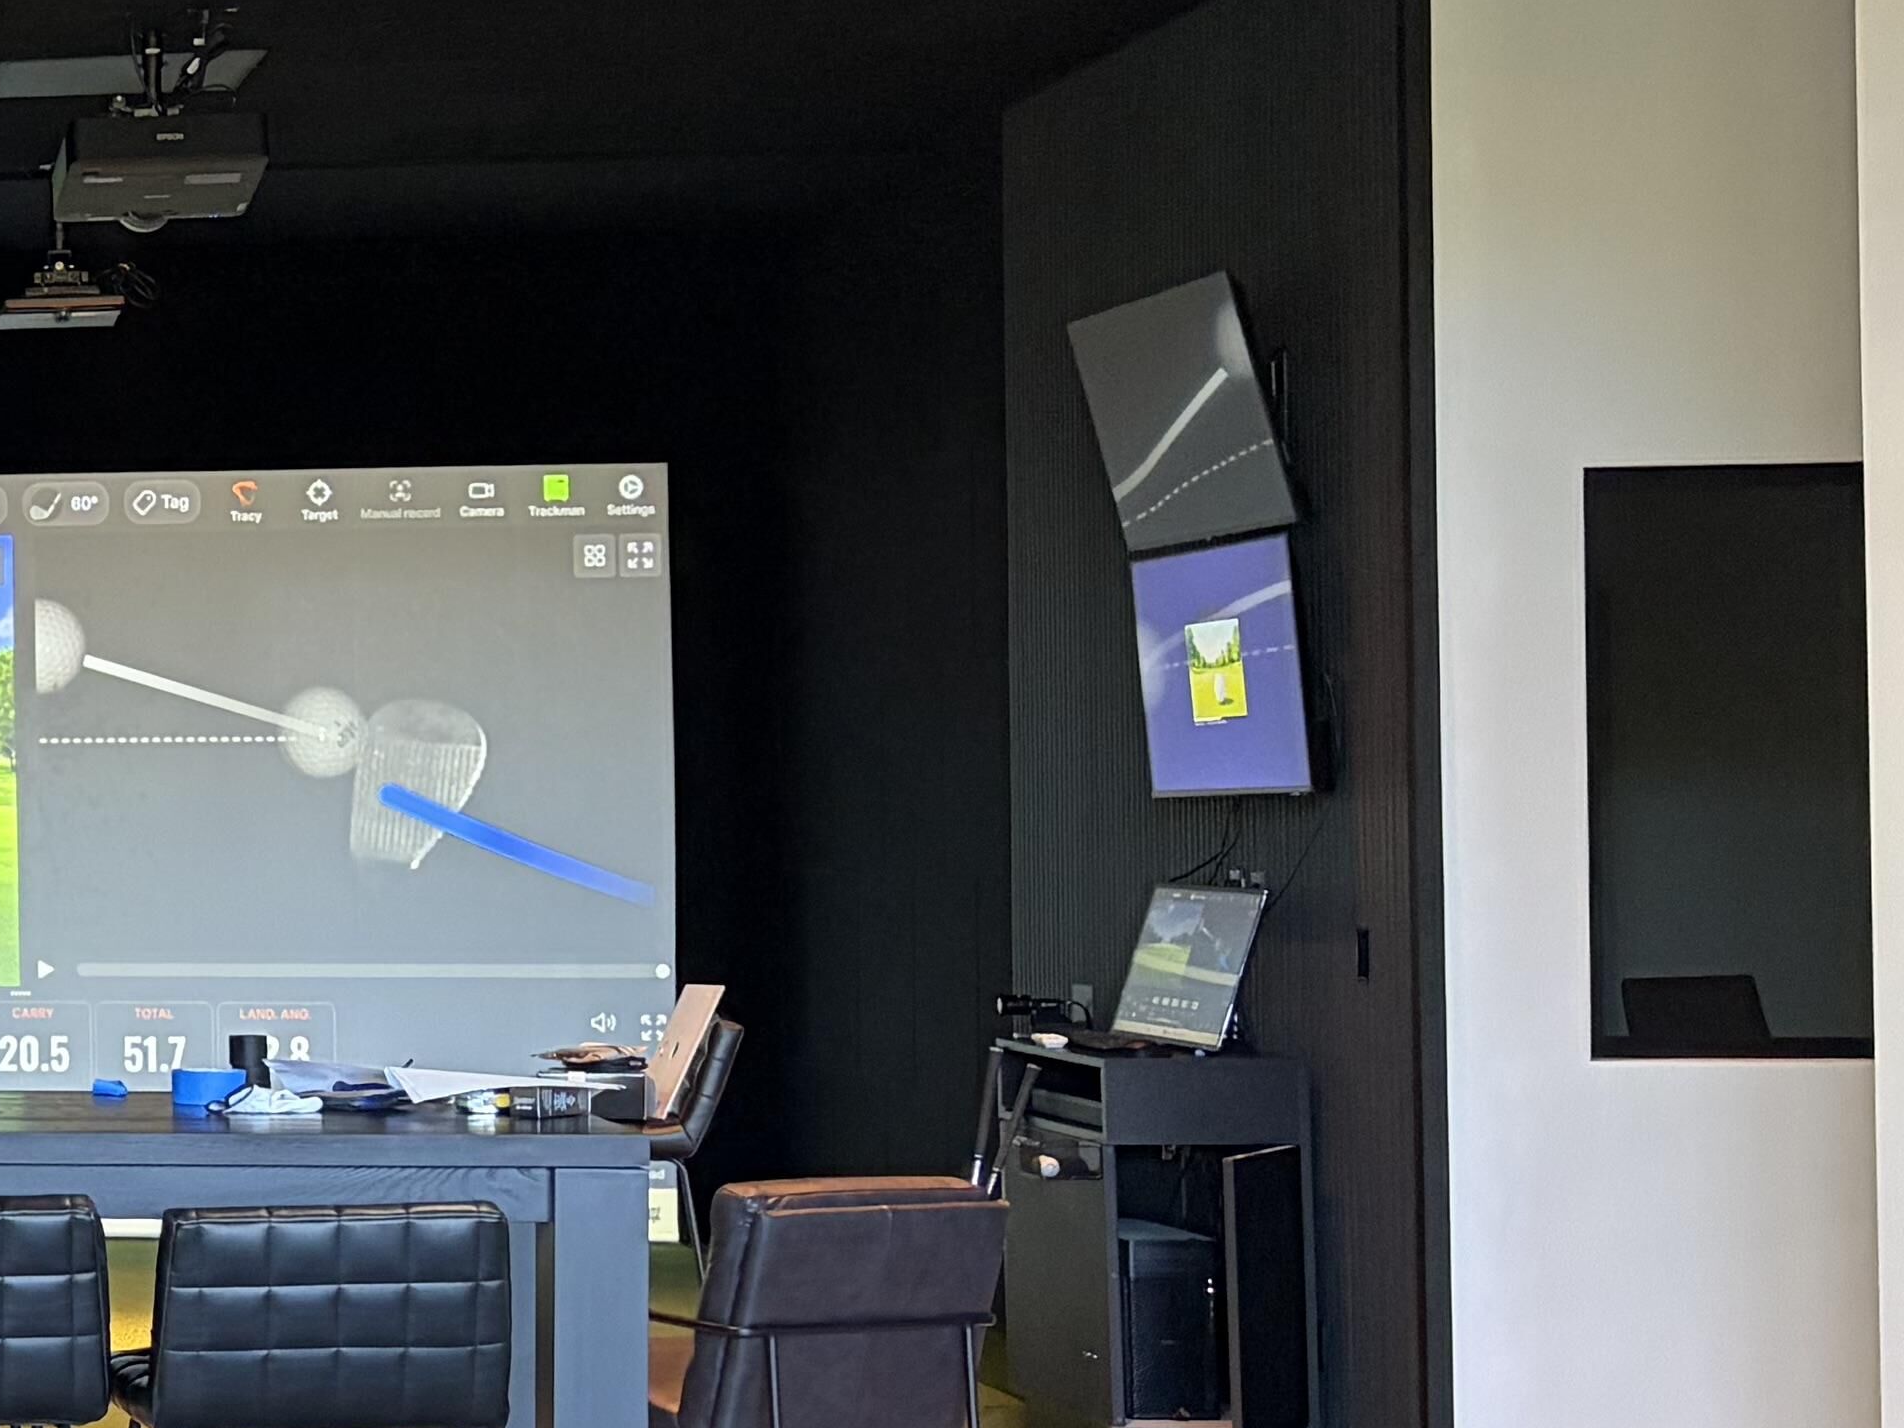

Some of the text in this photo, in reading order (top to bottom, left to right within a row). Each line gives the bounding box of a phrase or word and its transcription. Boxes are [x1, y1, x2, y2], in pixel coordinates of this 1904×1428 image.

[160, 494, 190, 512] Tag
[230, 510, 263, 523] Tracy
[301, 509, 339, 523] Target
[360, 507, 441, 519] Manual record
[459, 505, 505, 517] Camera
[528, 504, 586, 517] Trackman
[607, 503, 656, 517] Settings
[12, 1007, 54, 1020] CARRY
[135, 1007, 174, 1020] TOTAL
[239, 1007, 311, 1020] LAND. ANG.
[123, 1035, 187, 1073] 51.7
